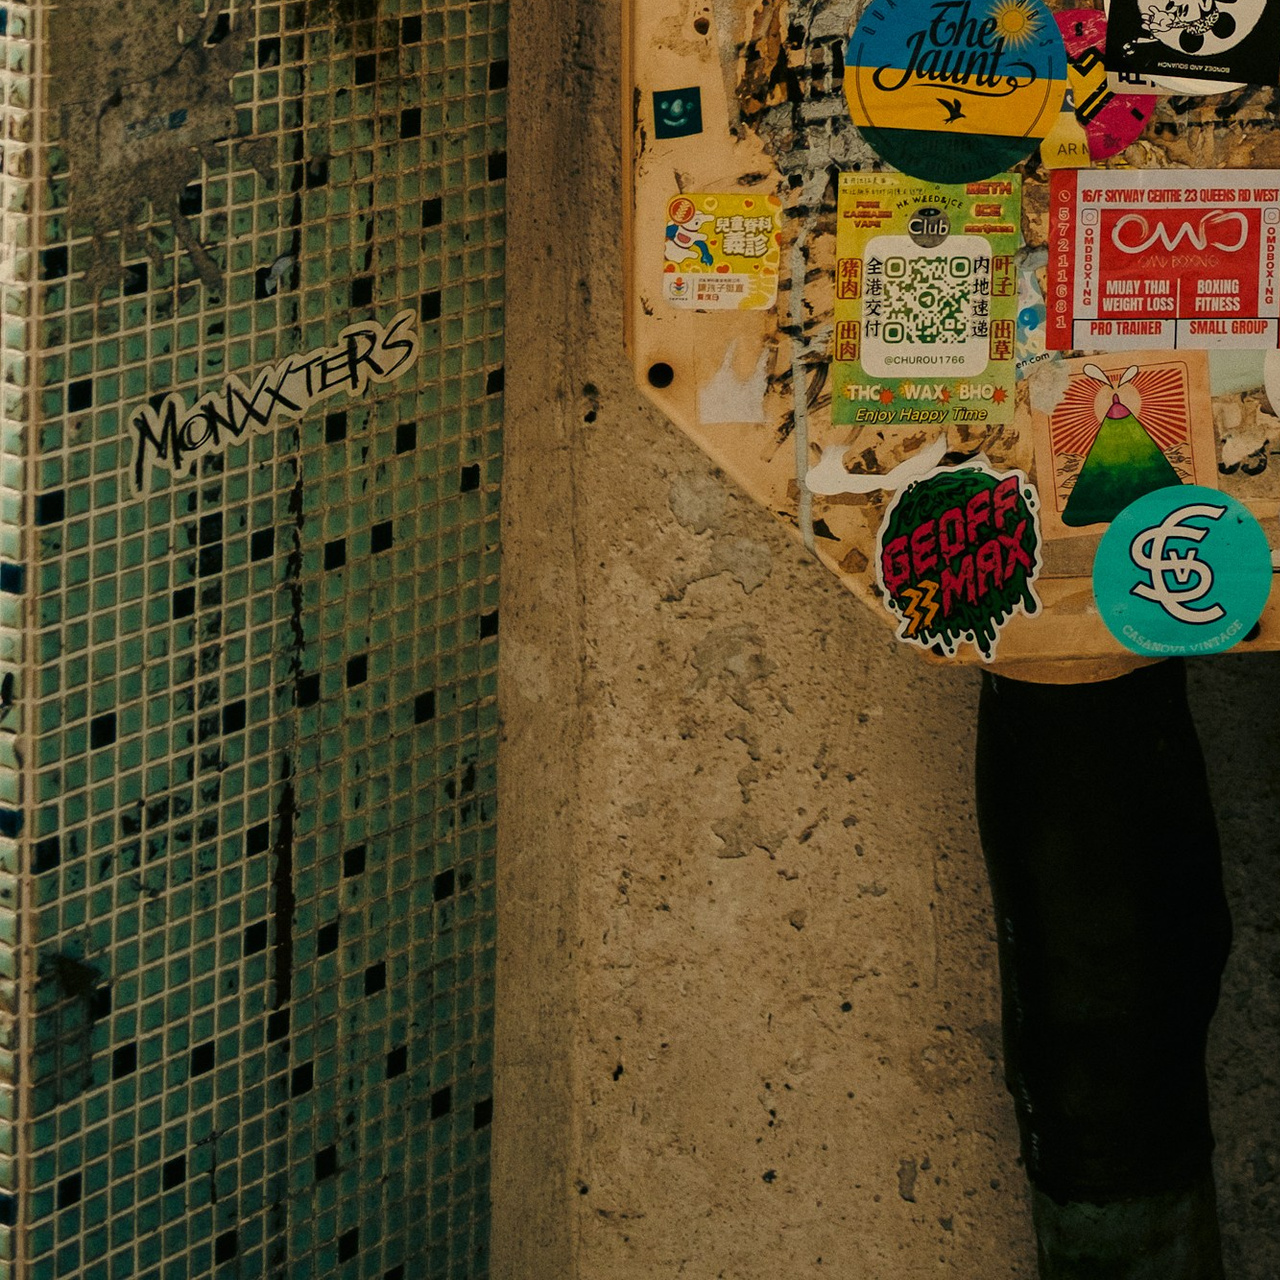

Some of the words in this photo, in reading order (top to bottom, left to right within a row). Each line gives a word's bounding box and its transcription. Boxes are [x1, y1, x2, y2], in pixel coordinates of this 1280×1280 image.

[930, 0, 997, 48] The
[872, 30, 1023, 91] Jaunt
[1082, 190, 1103, 202] 16/F
[1105, 190, 1144, 202] SKYWAY
[1147, 190, 1181, 202] CENTRE
[1184, 190, 1197, 202] 23
[1200, 190, 1235, 202] QUEENS
[1238, 190, 1250, 202] RD
[1254, 190, 1278, 202] WEST
[908, 219, 949, 235] Club
[841, 260, 859, 294] 猪肉
[1056, 207, 1069, 328] 57211681
[1083, 228, 1093, 305] OMDBOXING
[1266, 227, 1276, 304] OMDBOXING
[865, 257, 882, 337] 全港交付
[971, 256, 990, 338] 内地速递
[1106, 280, 1142, 295] MUAY
[1144, 280, 1170, 294] THAI
[1197, 279, 1239, 294] BOXING
[1103, 297, 1145, 311] WEIGHT
[1147, 297, 1174, 311] LOSS
[1195, 297, 1240, 312] FITNESS
[840, 324, 858, 359] 出肉
[1091, 321, 1111, 335] PRO
[1117, 321, 1161, 335] TRAINER
[1190, 321, 1227, 334] SMALL
[1232, 320, 1268, 334] GROUP
[885, 356, 965, 365] @CHUROU1766
[850, 385, 881, 401] THC
[904, 385, 943, 401] WAX
[960, 385, 994, 401] BHO
[856, 409, 896, 424] Enjoy
[900, 408, 948, 423] Happy
[952, 407, 987, 420] Time
[883, 476, 1019, 598] GEOFF
[941, 520, 1032, 618] MAX
[1122, 624, 1186, 654] CASANOVA
[1190, 620, 1243, 653] VINTAGE
